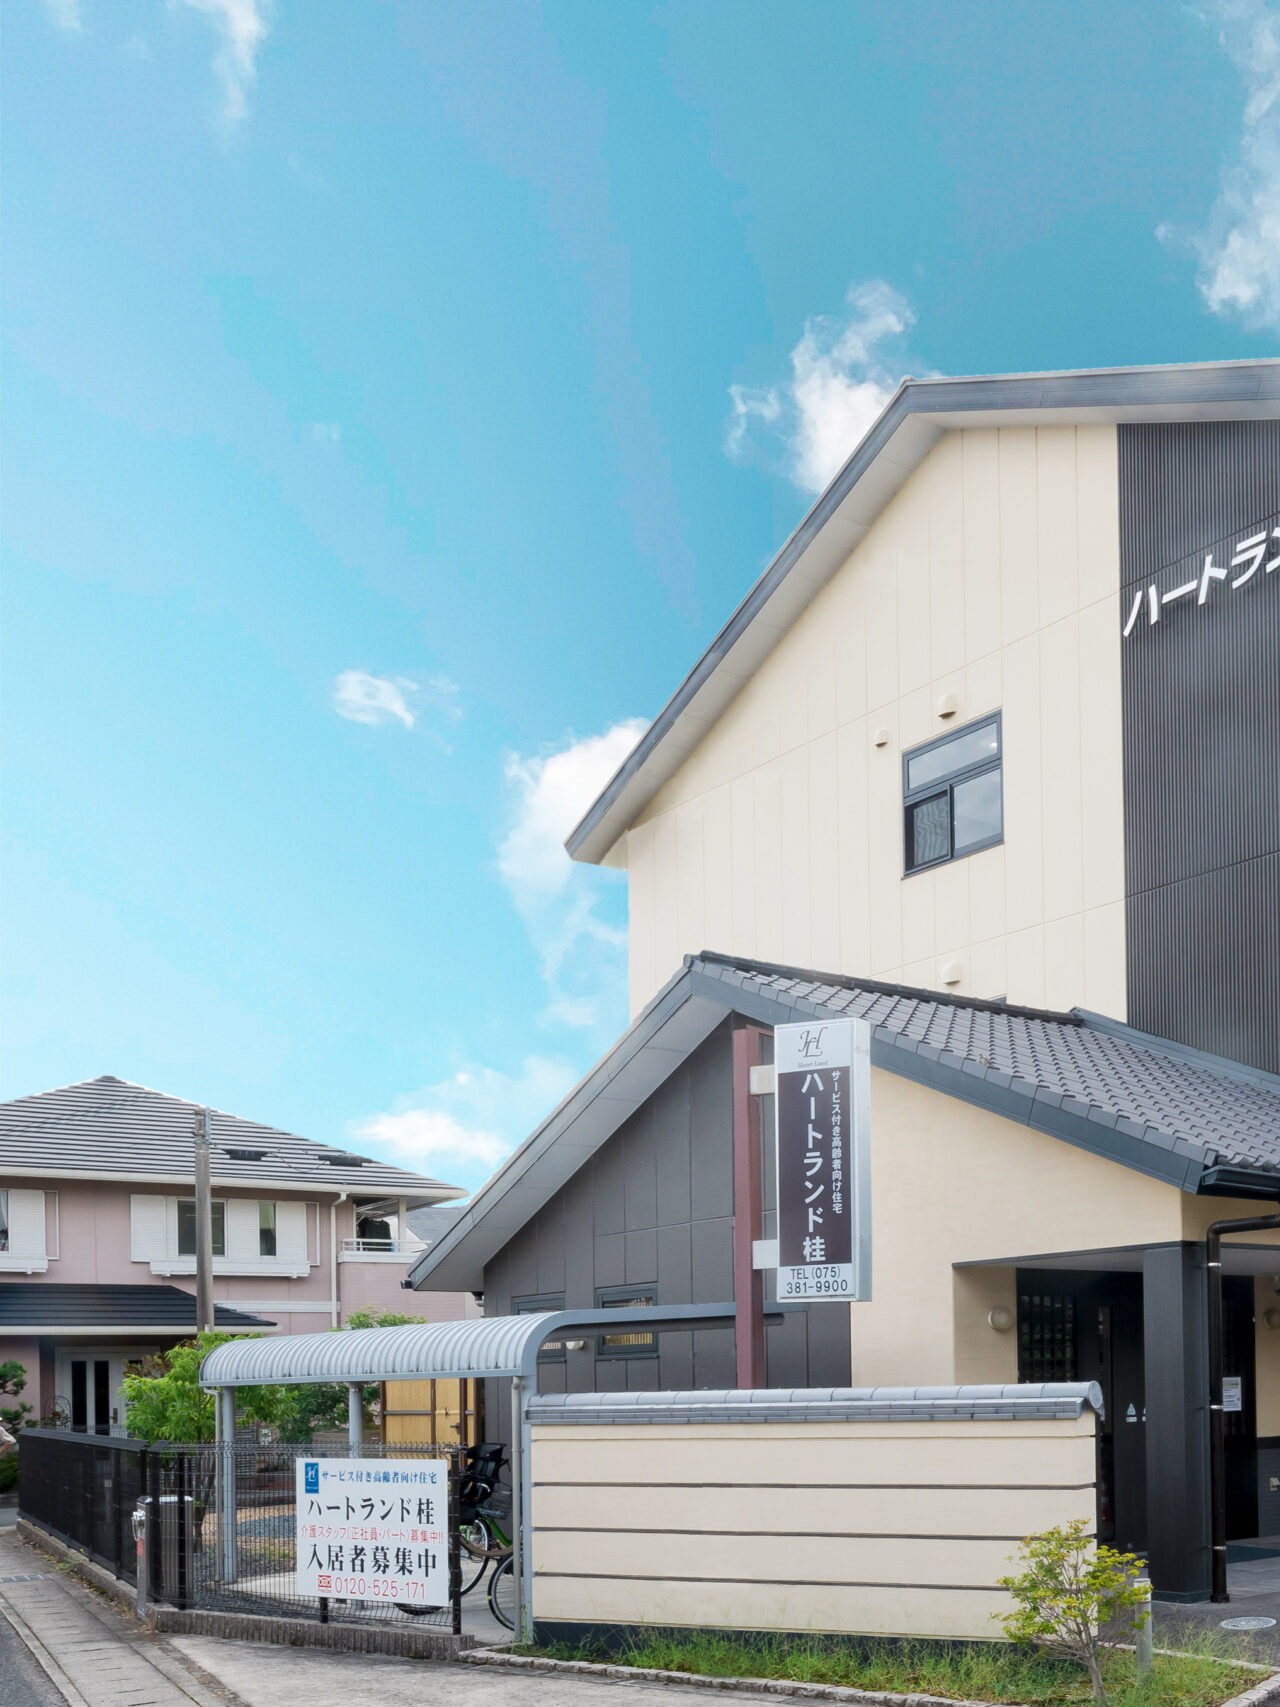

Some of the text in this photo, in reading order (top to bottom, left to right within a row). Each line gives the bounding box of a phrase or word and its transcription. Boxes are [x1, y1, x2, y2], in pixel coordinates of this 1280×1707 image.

[831, 1070, 843, 1214] サービス付き高齢者向け住宅
[801, 1072, 826, 1262] ハートランド桂
[787, 1279, 848, 1294] 381-9900
[321, 1470, 438, 1485] サービス付き高齢者向け住宅
[307, 1496, 435, 1525] ハートランド桂
[306, 1543, 437, 1578] 入居者募集中
[335, 1576, 425, 1600] 0120-525-171
